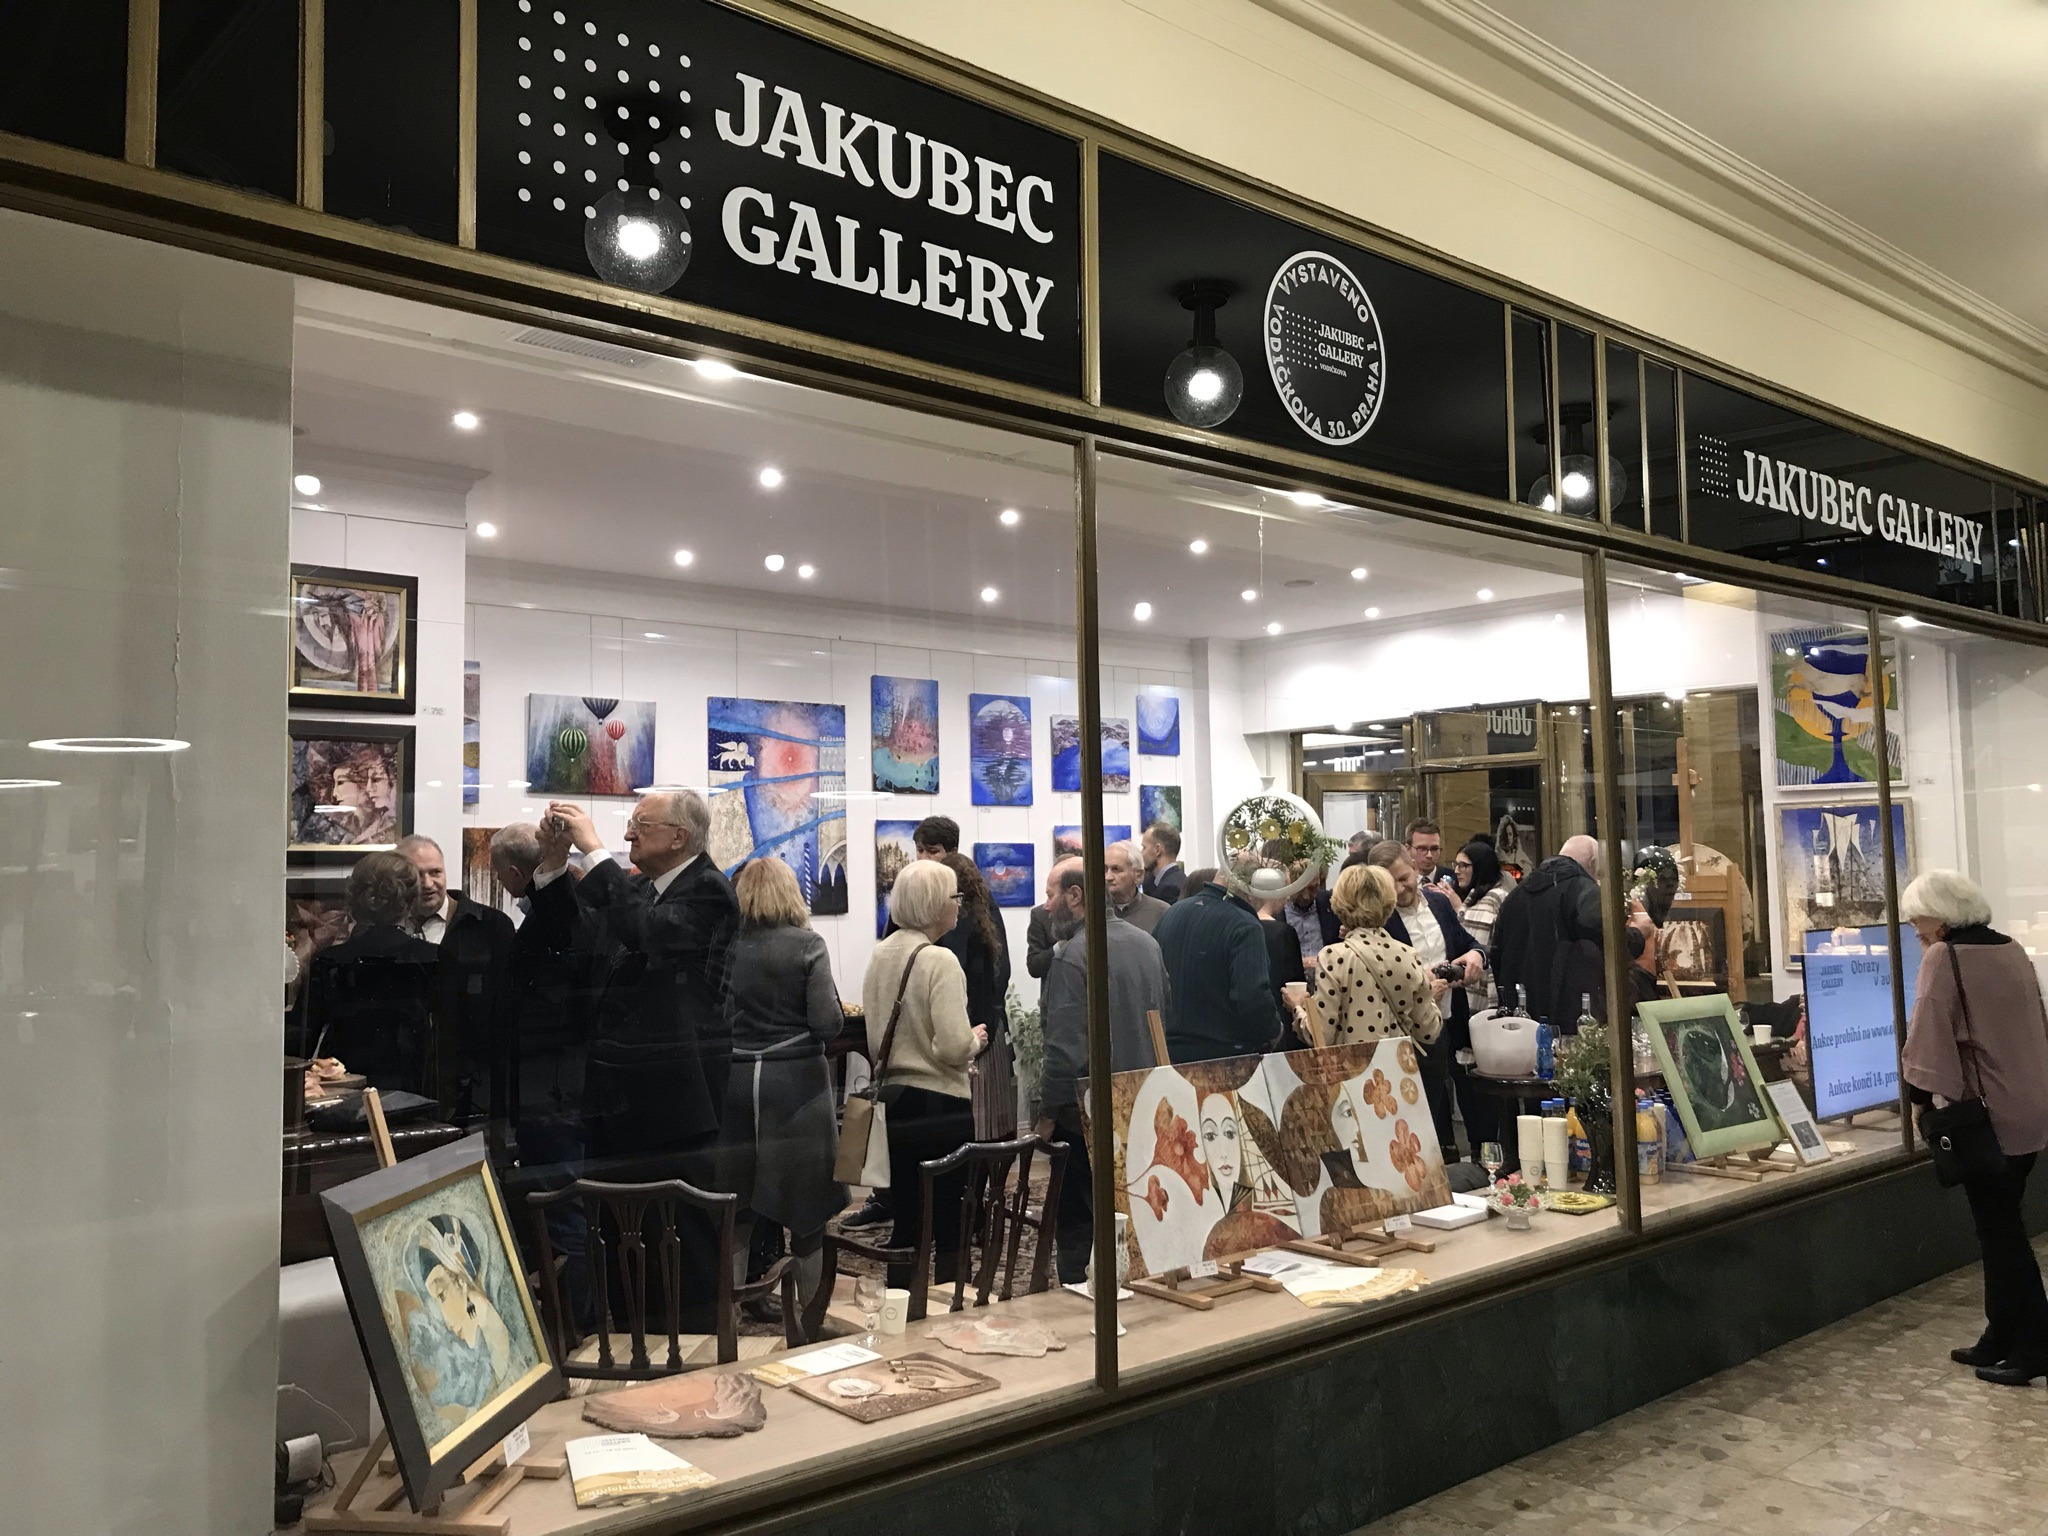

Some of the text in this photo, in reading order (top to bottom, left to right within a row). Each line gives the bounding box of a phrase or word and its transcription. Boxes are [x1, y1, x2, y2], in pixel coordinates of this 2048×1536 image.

[715, 72, 1054, 243] JAKUBEC
[721, 186, 1055, 341] GALLERY
[1278, 263, 1369, 322] VYSTAVENO
[1318, 323, 1365, 350] JAKUBEC
[1270, 303, 1323, 434] VODIČKOVA
[1352, 360, 1379, 429] PRAHA
[1318, 342, 1365, 369] GALLERY
[1736, 450, 1984, 565] JAKUBEC GALLERY
[1851, 960, 1880, 974] Obrazy
[1873, 975, 1891, 986] v au
[1812, 1033, 1834, 1049] Aukce
[1862, 1029, 1871, 1040] na
[1828, 1079, 1851, 1097] Aukce
[1852, 1071, 1872, 1091] končí
[1873, 1071, 1885, 1087] 14.
